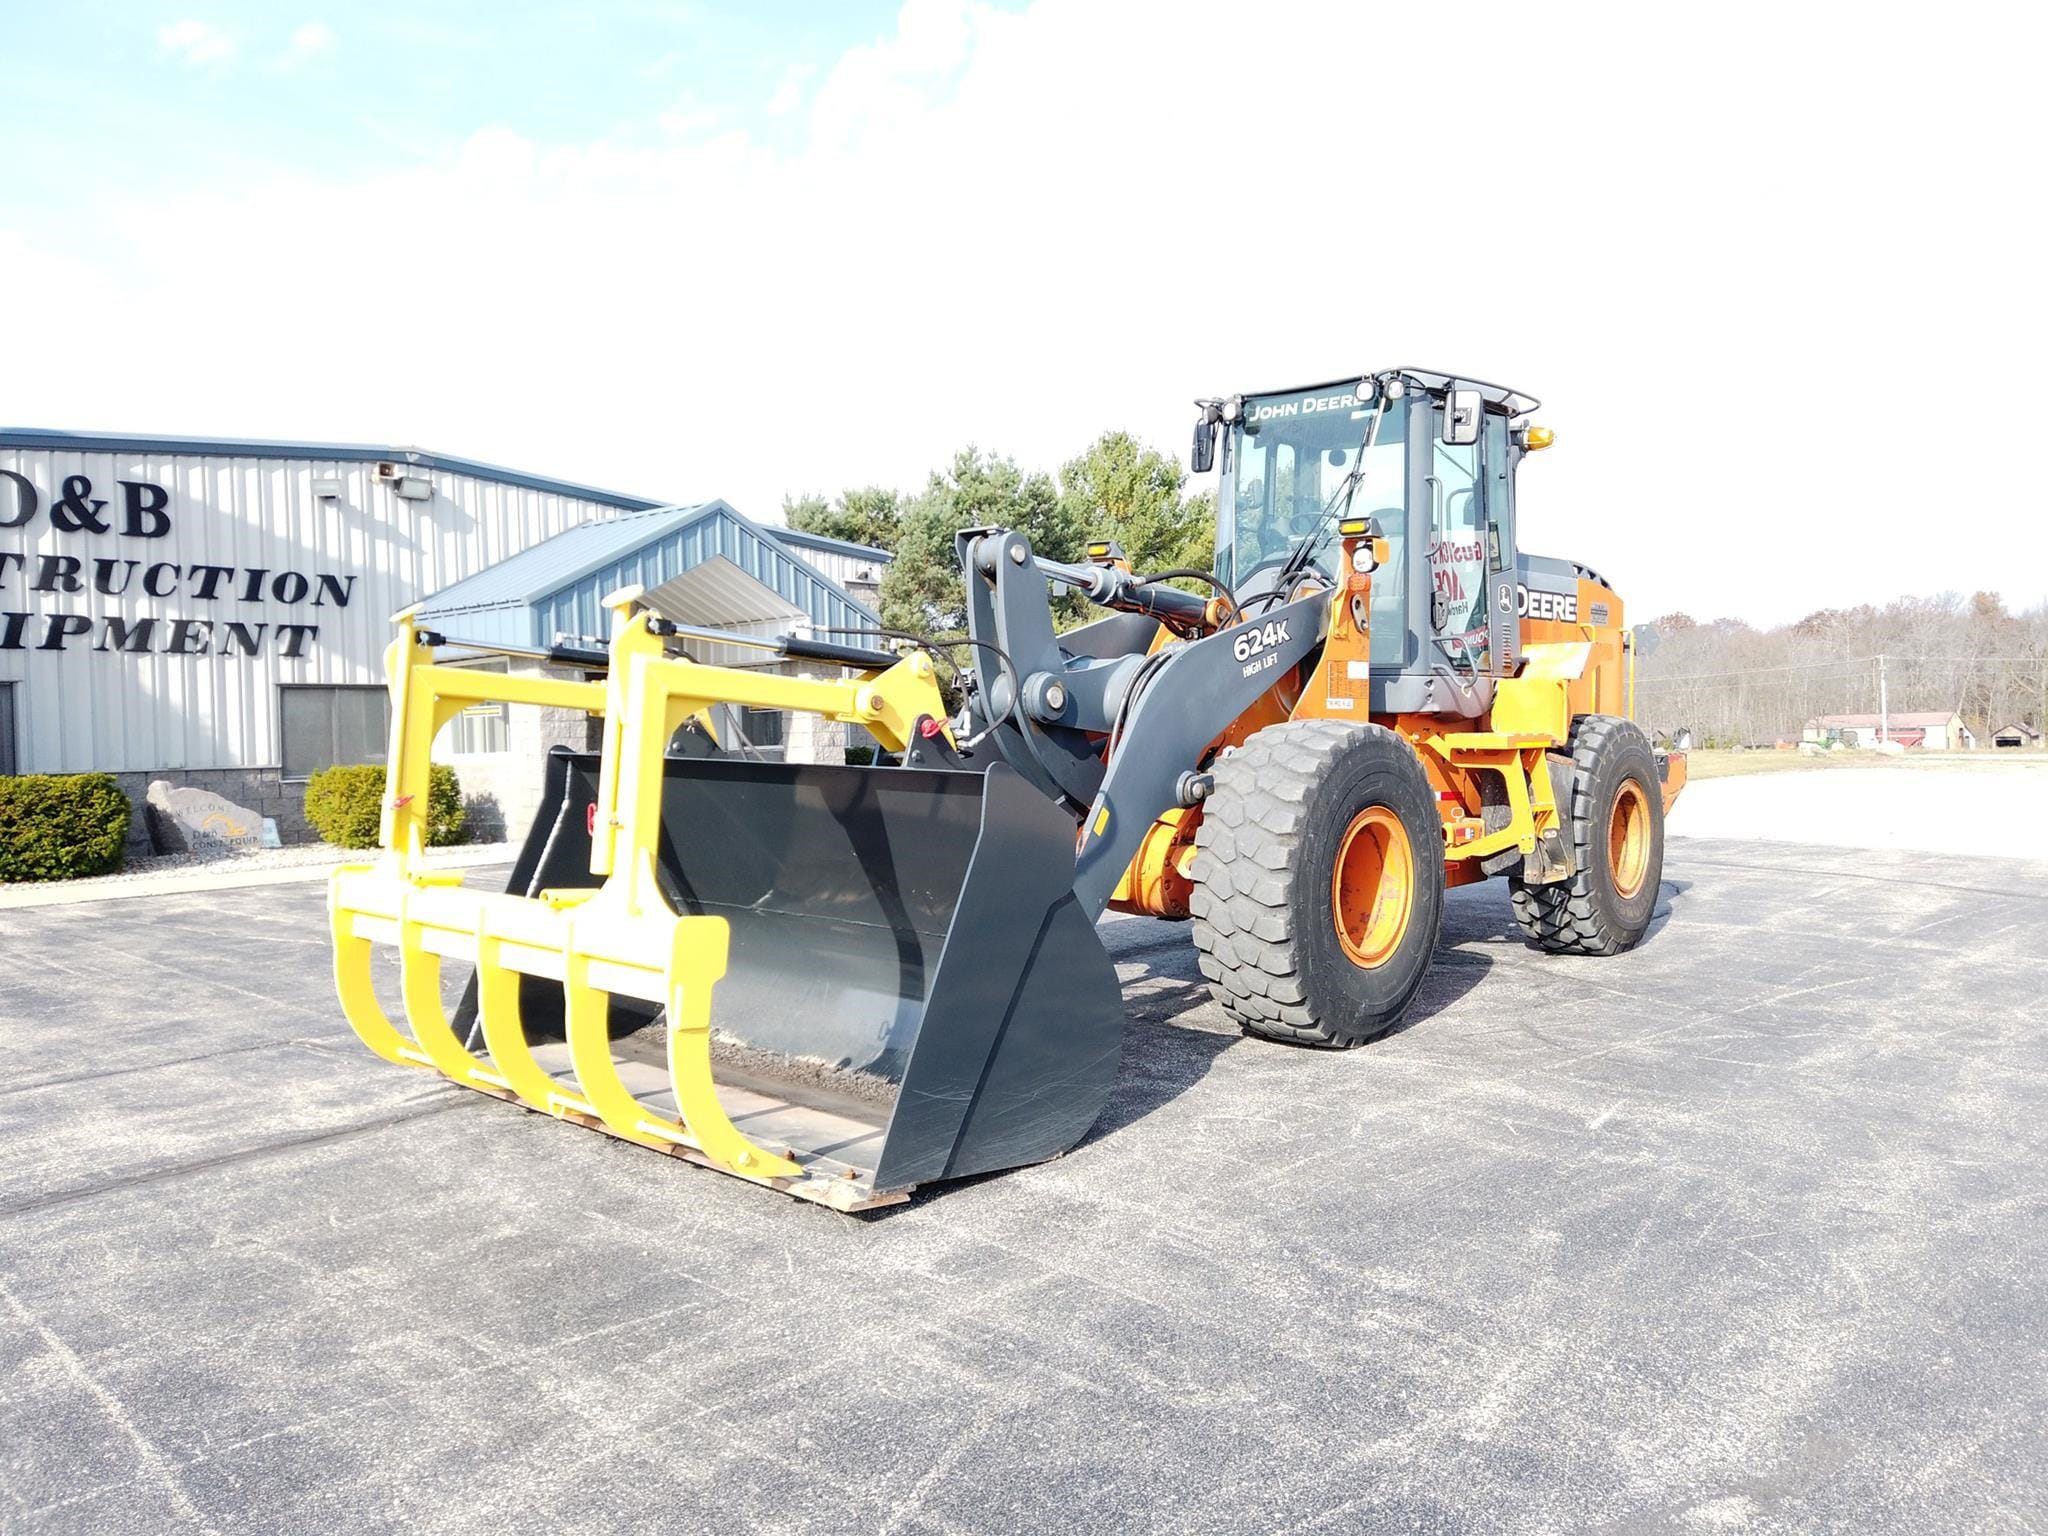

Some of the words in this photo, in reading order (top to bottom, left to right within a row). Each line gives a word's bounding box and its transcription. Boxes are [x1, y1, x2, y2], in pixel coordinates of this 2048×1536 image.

[1248, 402, 1298, 421] JOHN
[1517, 582, 1577, 624] DEERE
[0, 612, 318, 657] IPMENT
[1233, 618, 1292, 662] 624K
[1242, 659, 1262, 678] HIGH
[1262, 652, 1278, 669] LIFT
